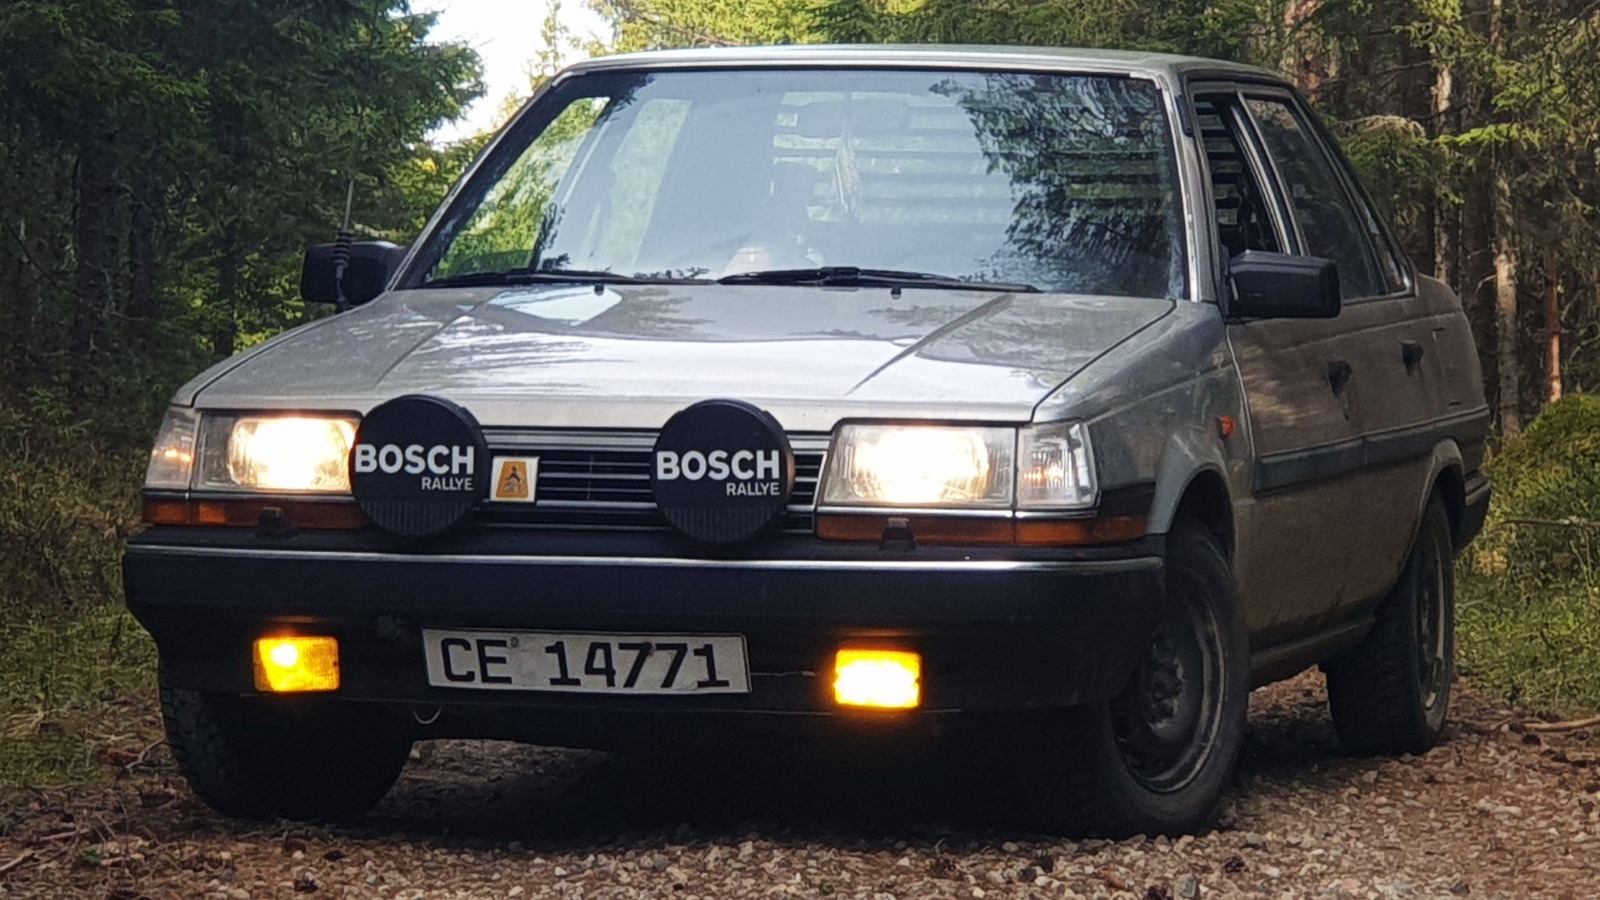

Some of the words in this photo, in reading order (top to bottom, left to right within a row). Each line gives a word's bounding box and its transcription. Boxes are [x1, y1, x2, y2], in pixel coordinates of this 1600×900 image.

[355, 443, 475, 475] BOSCH
[656, 449, 780, 481] BOSCH
[421, 476, 474, 491] RALLYE
[726, 482, 780, 496] RALLYE
[441, 637, 512, 685] CE
[545, 641, 730, 689] 14771
